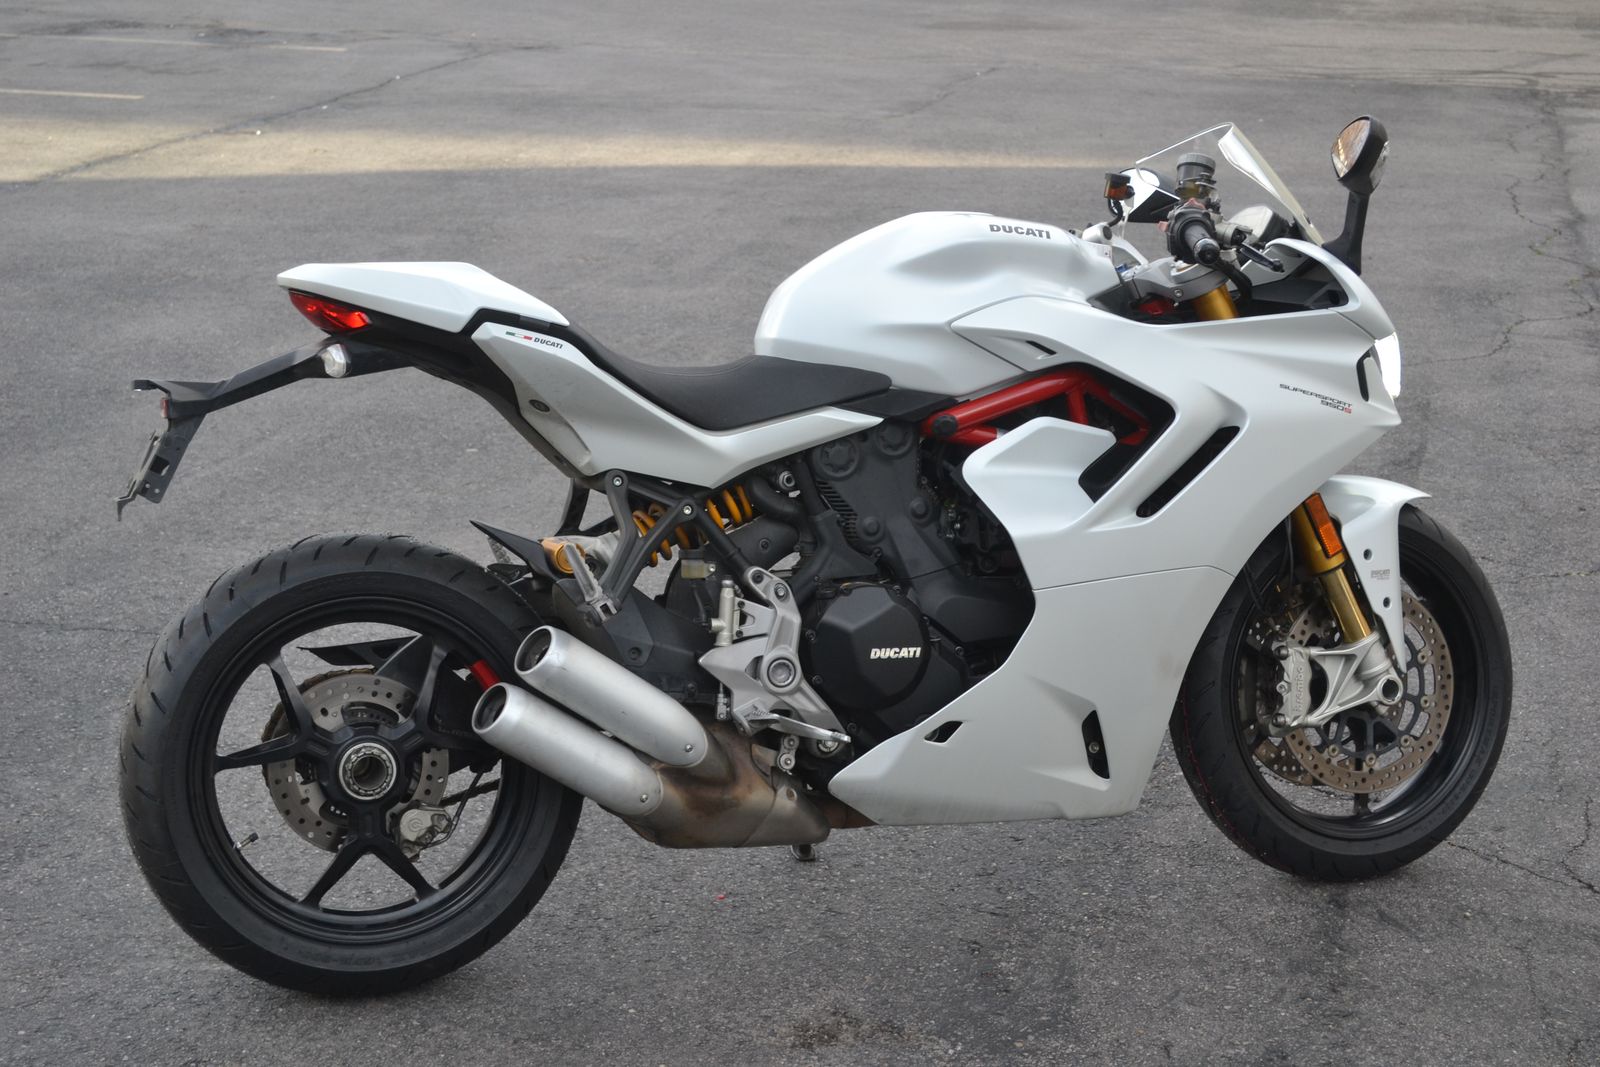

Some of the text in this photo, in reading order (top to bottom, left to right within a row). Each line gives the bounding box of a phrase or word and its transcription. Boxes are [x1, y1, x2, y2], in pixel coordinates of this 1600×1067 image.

[989, 224, 1051, 239] DUCATI
[534, 337, 563, 349] DUCATI
[1280, 383, 1352, 408] SUPERSPORT
[870, 647, 921, 659] DUCATI
